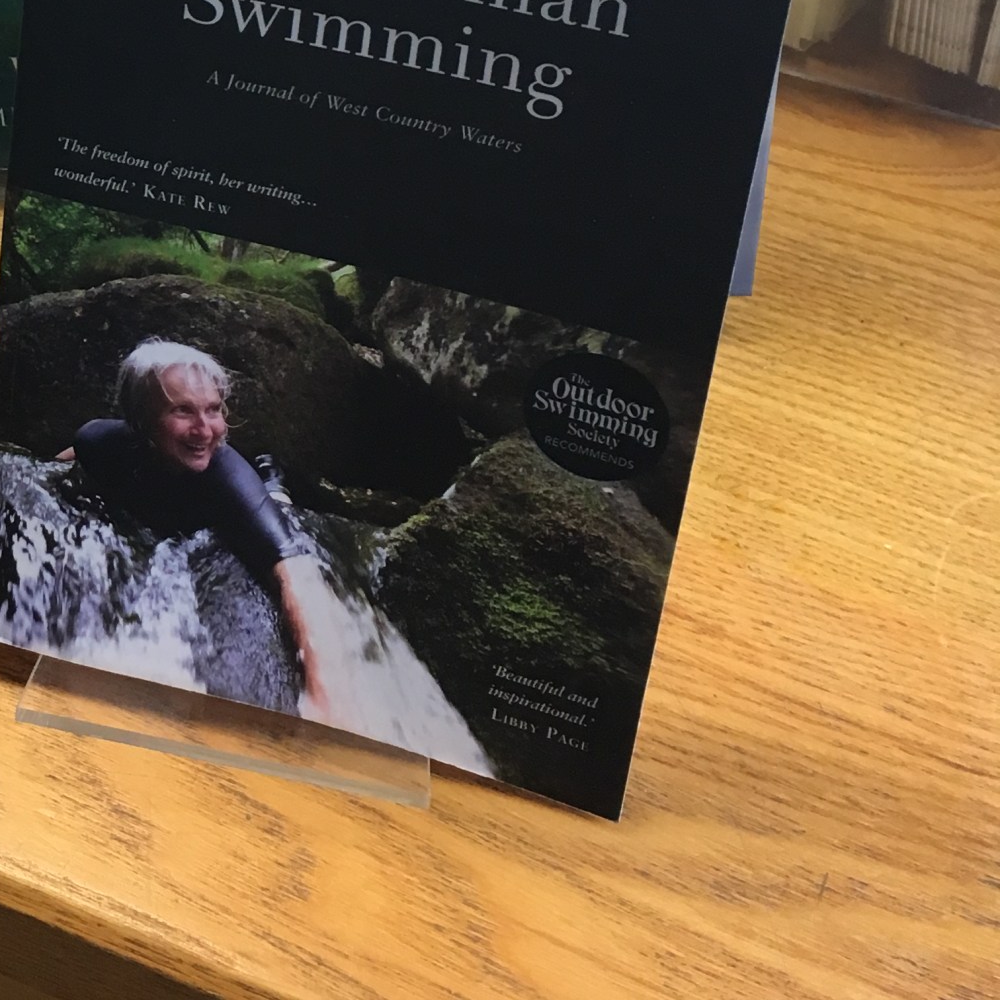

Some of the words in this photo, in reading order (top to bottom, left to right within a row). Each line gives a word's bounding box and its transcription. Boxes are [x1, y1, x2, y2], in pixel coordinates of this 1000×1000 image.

[206, 70, 220, 86] A
[224, 73, 296, 101] Journal
[299, 91, 322, 109] of
[326, 94, 370, 117] West
[375, 106, 452, 140] Country
[460, 124, 523, 154] Waters
[90, 144, 149, 170] freedom
[153, 160, 172, 176] of
[171, 165, 214, 185] spirit,
[219, 173, 244, 190] her
[143, 184, 186, 206] KATE
[570, 372, 591, 387] The
[552, 377, 655, 421] Outdoor
[533, 389, 659, 448] Swimming
[567, 422, 620, 450] Society
[544, 435, 635, 470] RECOMMENDS
[567, 693, 599, 709] and
